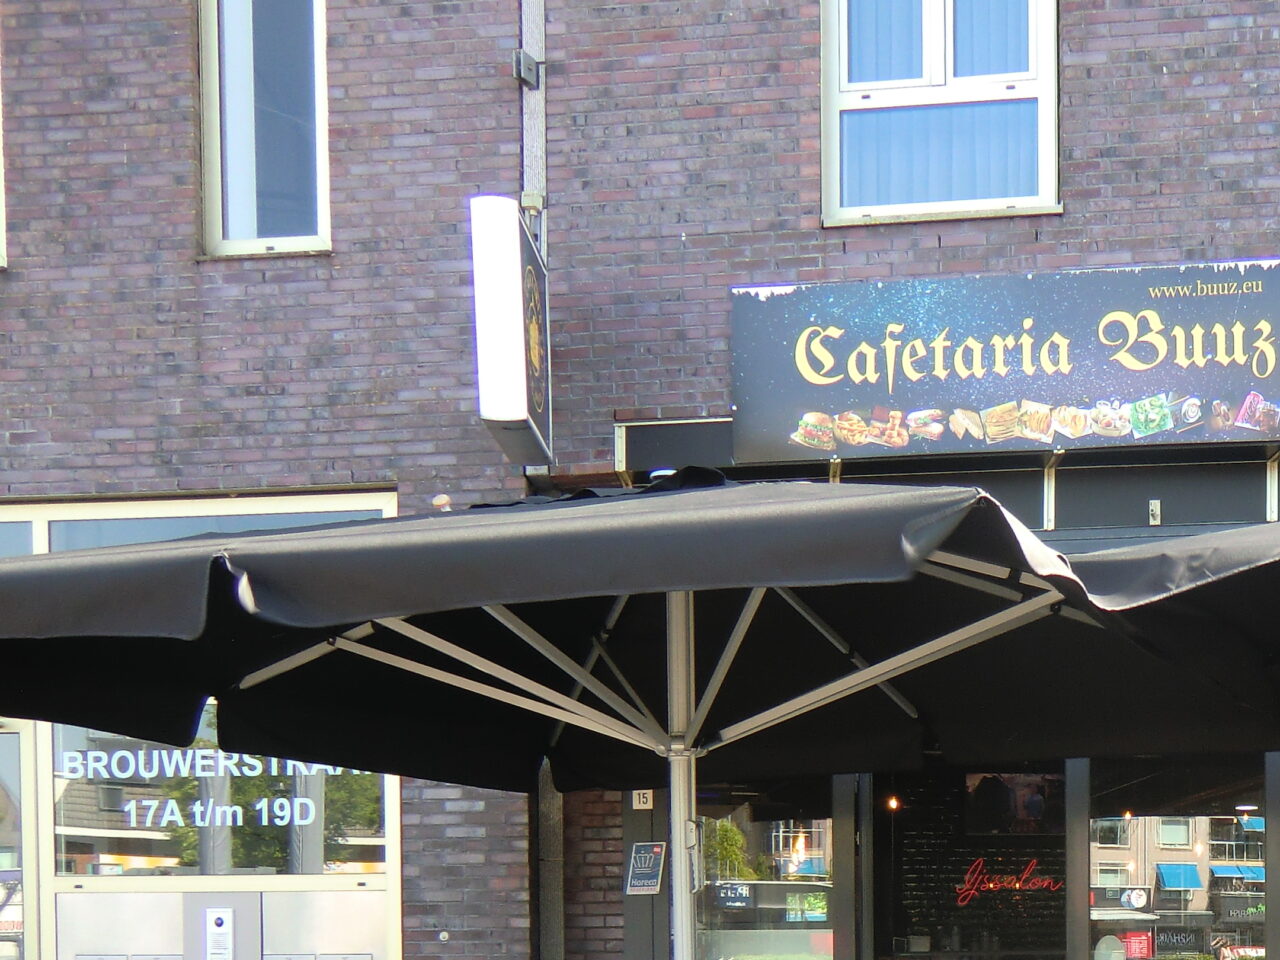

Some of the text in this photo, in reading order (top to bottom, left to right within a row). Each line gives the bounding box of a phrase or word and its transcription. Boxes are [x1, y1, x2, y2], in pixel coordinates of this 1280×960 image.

[1148, 280, 1263, 299] www.buuz.eu
[794, 309, 1276, 395] Cafetaria Buuz
[637, 792, 648, 805] 15
[124, 797, 316, 828] 17A t/m 19D
[631, 879, 657, 887] Horeca
